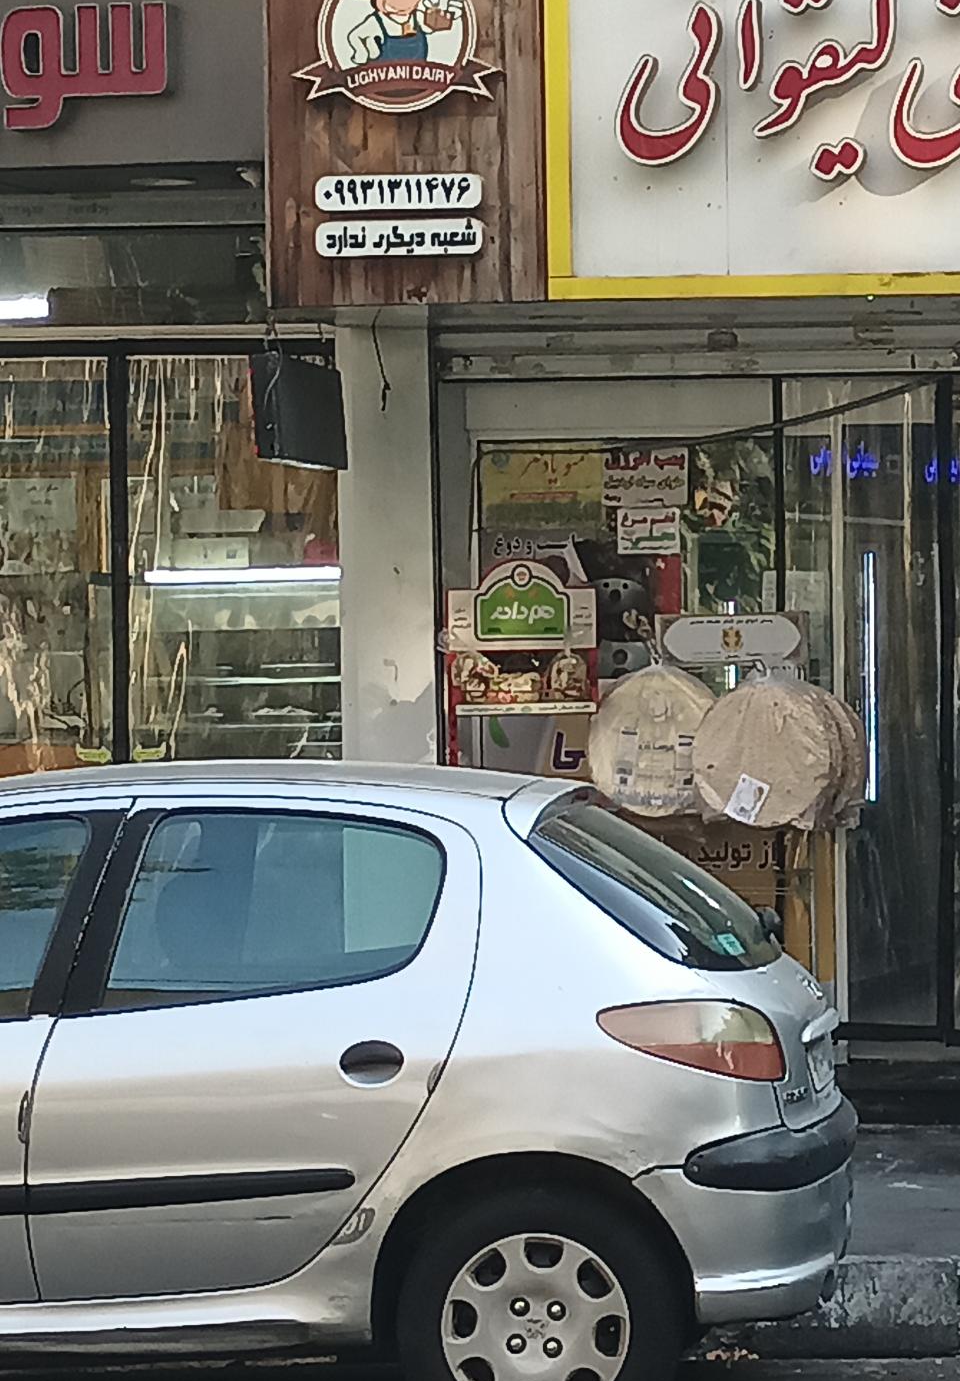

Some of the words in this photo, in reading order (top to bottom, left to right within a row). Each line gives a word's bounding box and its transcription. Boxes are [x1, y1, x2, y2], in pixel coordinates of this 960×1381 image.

[347, 66, 410, 88] LIGHVANI
[412, 66, 454, 86] DAIRY
[323, 176, 472, 206] ۰۹۹۳۱۳۱۱۴۷۶
[326, 225, 367, 255] ندارد
[430, 217, 477, 254] شعبه
[697, 840, 752, 869] تولید
